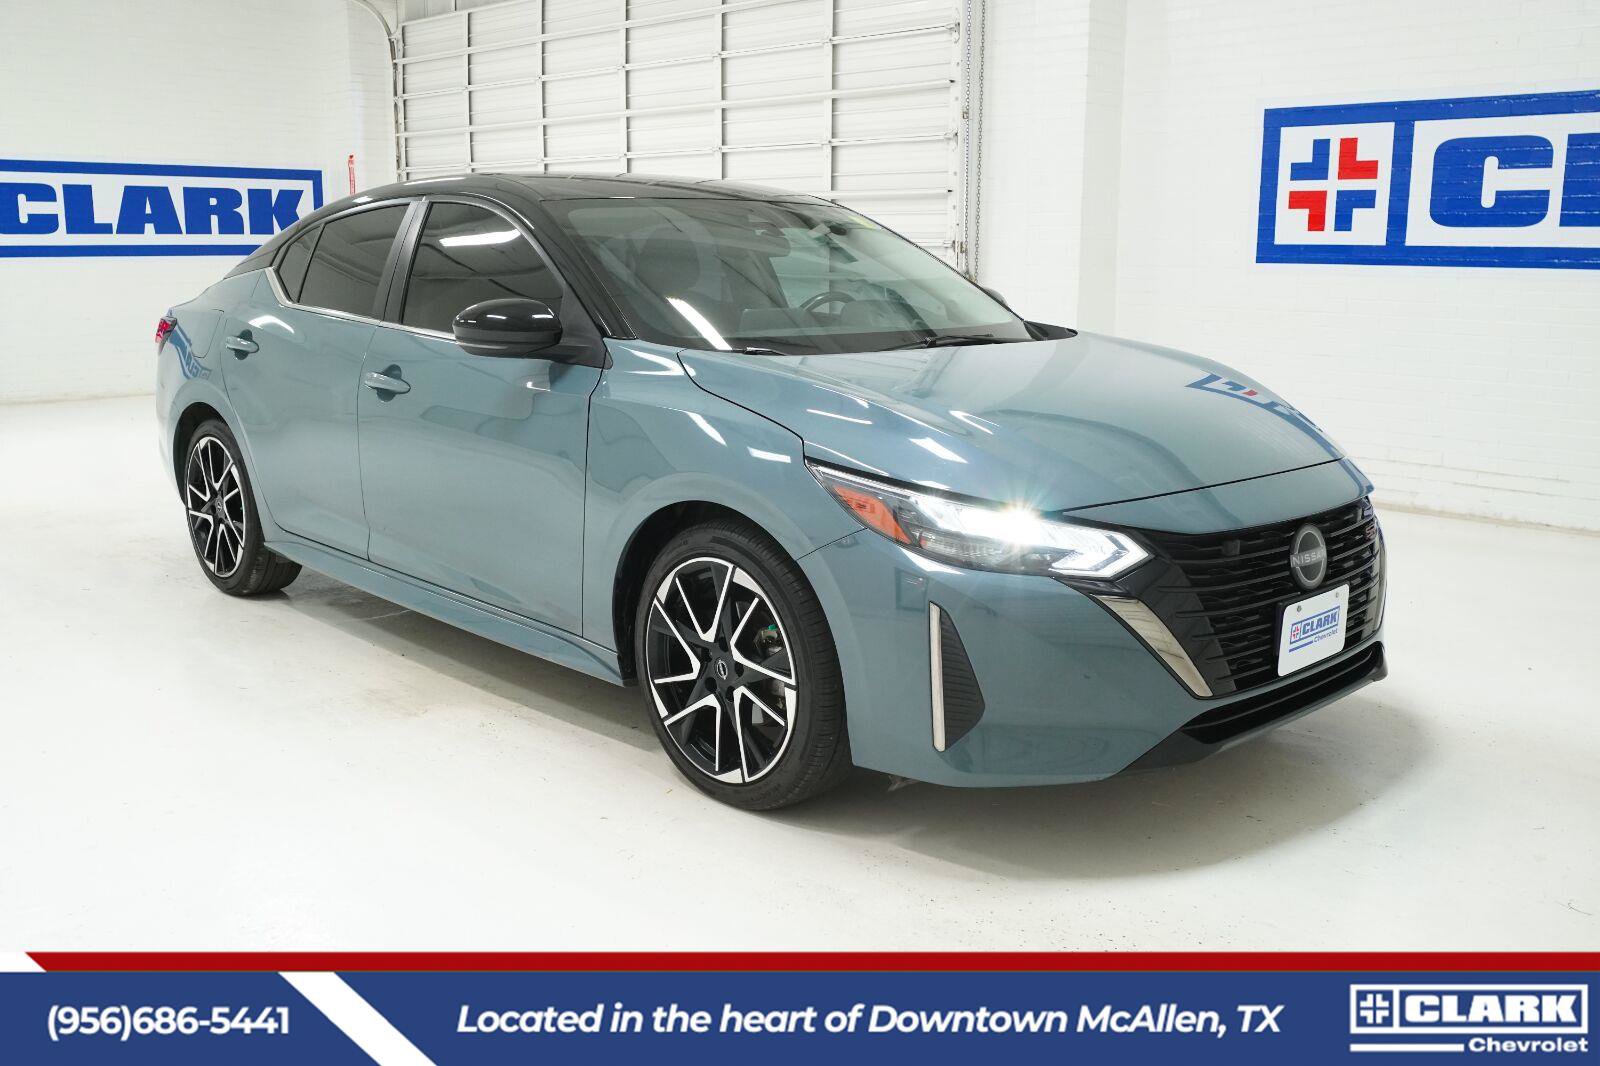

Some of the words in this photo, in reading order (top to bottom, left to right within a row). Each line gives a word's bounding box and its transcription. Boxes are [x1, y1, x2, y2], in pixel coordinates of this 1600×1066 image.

[0, 182, 304, 235] CLARK
[1292, 549, 1326, 566] NISSAN
[1301, 611, 1338, 636] CLARK
[1313, 628, 1339, 643] Chevrolet
